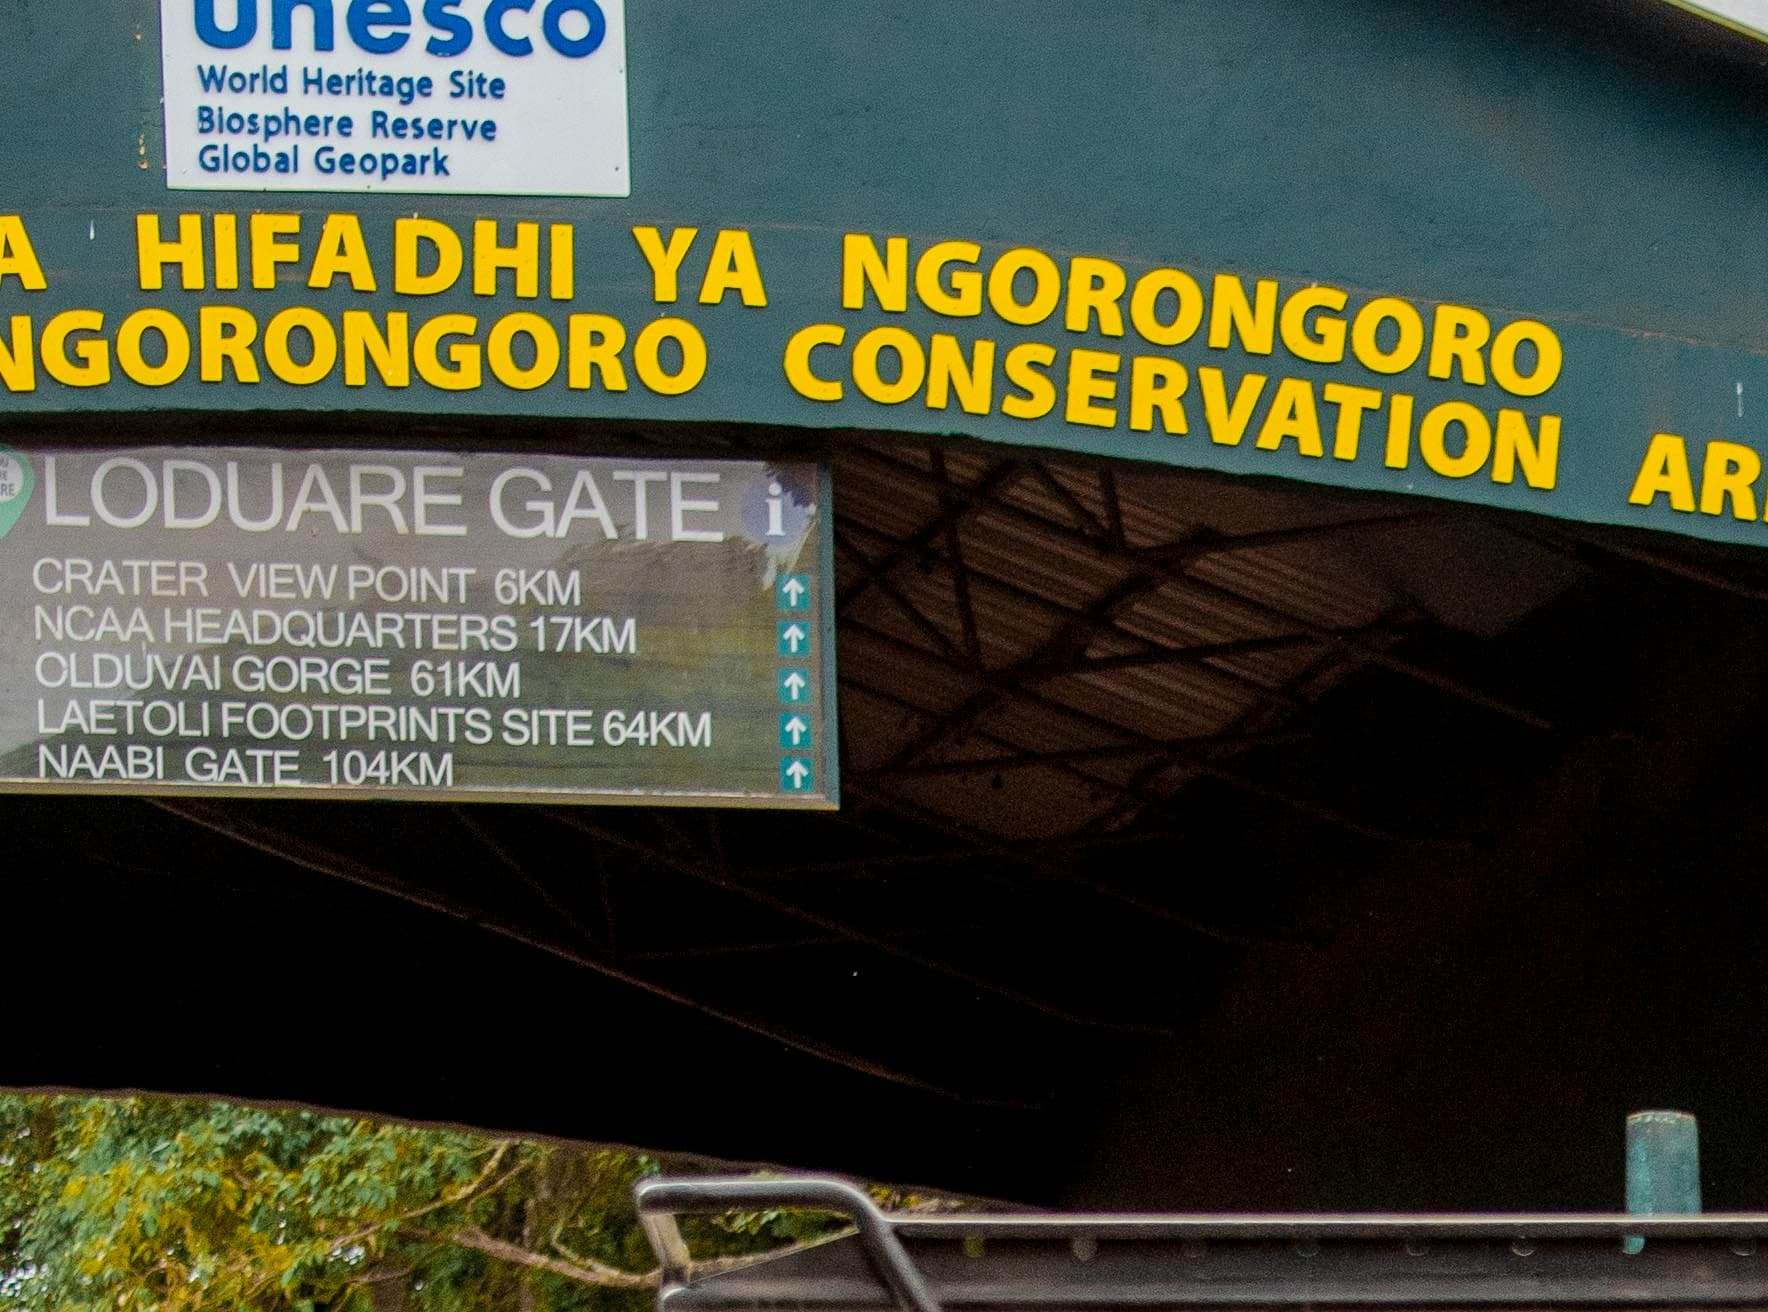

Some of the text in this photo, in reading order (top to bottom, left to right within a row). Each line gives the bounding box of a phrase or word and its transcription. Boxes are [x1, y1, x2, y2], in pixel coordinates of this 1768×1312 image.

[194, 0, 607, 58] unesco
[197, 64, 507, 105] World Heritage Site
[197, 105, 497, 142] Biosphere Reserve
[198, 144, 450, 180] Global Geopark
[135, 212, 575, 300] HIFADHI
[632, 225, 768, 308] YA
[841, 232, 1563, 397] NGORONGORO
[0, 305, 708, 396] NGORONGORO
[783, 322, 1562, 491] CONSERVATION
[44, 456, 724, 543] LODUARE GATE
[32, 557, 582, 607] CRATER VIEW POINT 6KM
[34, 605, 637, 654] NCAA HEADQUARTERS 17KM
[35, 651, 521, 698] OLDUVAI GORGE 61KM
[37, 699, 713, 748] LAETOLI FOOTPRINTS SITE 64KM
[38, 744, 454, 787] NAABI GATE 104KM
